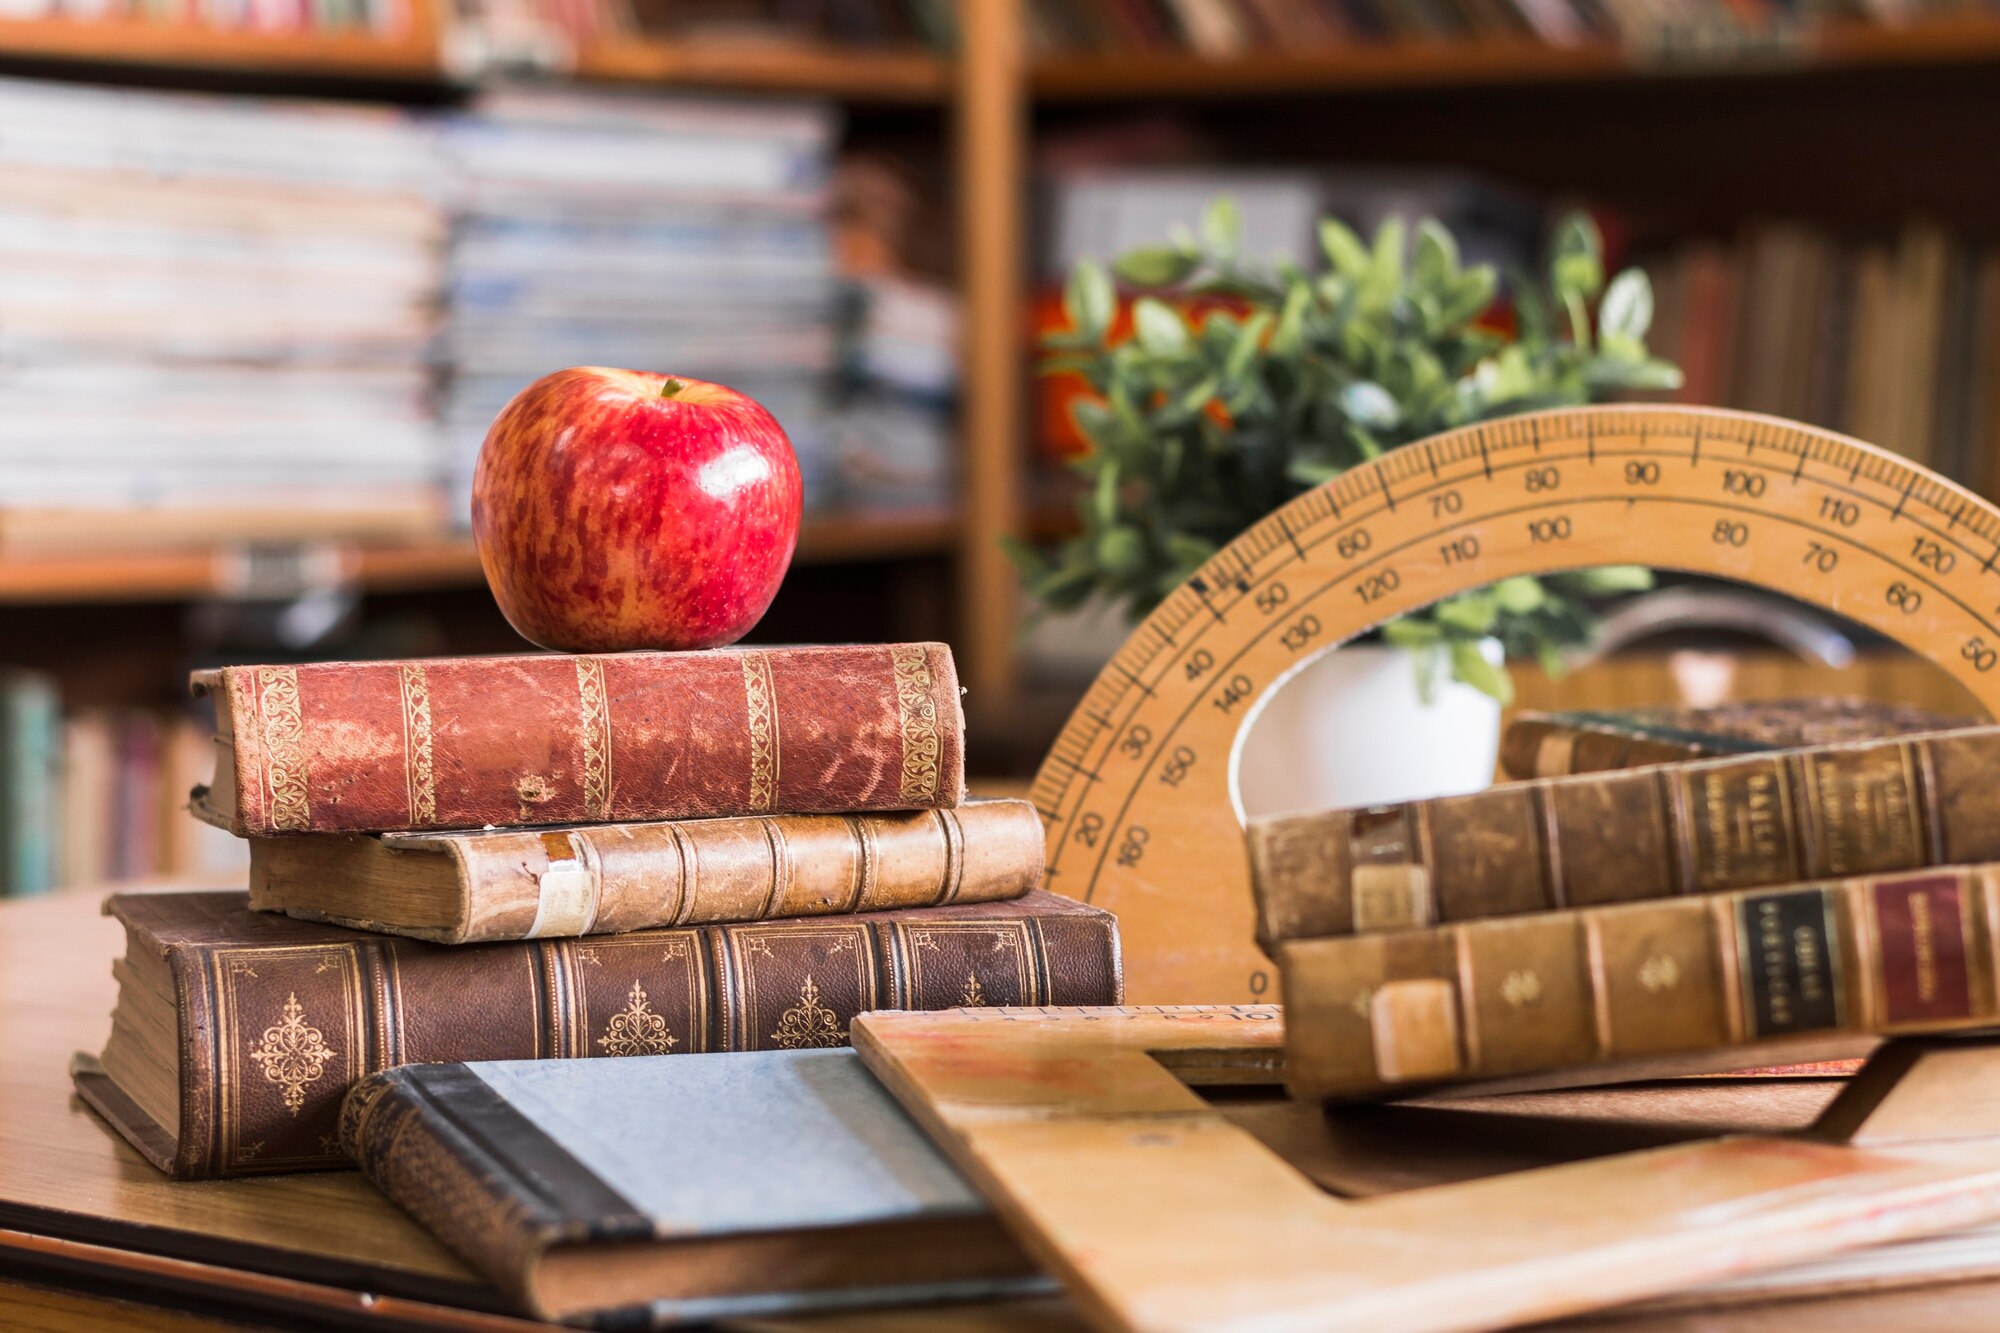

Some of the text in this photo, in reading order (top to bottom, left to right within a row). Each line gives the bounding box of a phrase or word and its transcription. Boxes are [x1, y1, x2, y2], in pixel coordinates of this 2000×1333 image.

[1075, 461, 1956, 849] 20 30 40 50 60 70 80 90 100 110 120
[1118, 516, 1997, 868] 160 150 140 130 120 110 100 80 70 60 50
[1225, 1012, 1274, 1021] 10
[1249, 971, 1269, 996] 0
